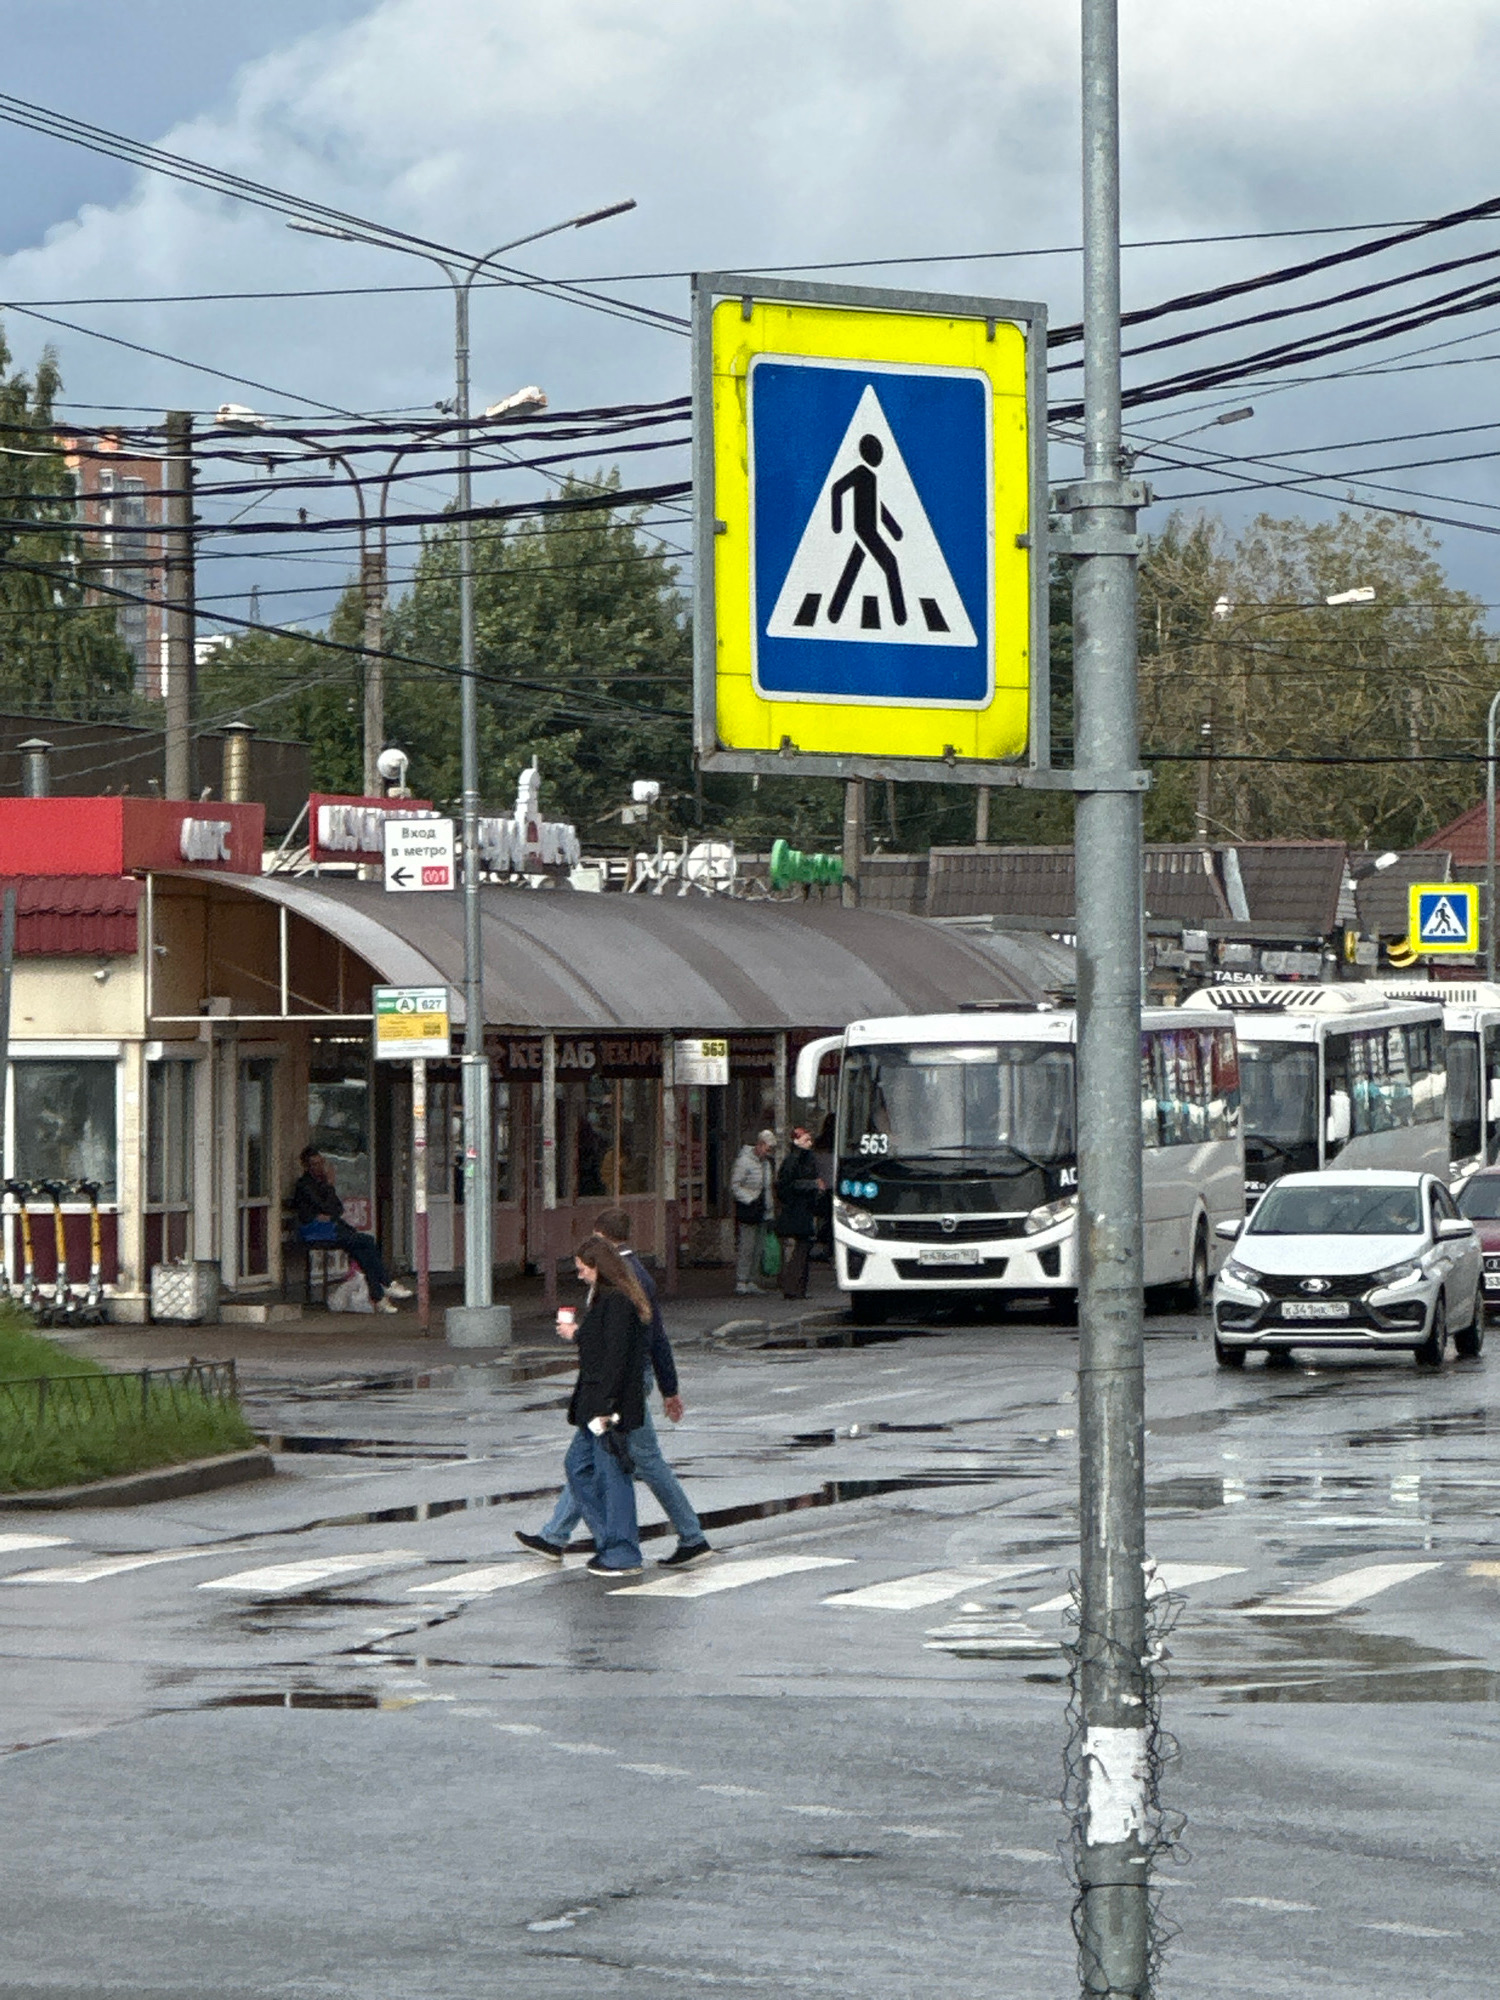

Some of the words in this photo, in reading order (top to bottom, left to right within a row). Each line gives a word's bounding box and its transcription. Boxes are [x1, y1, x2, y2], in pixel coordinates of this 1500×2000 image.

[401, 827, 436, 840] Вход
[391, 848, 399, 857] в
[404, 846, 447, 858] метро
[1213, 970, 1264, 984] ТАБАК
[421, 999, 442, 1010] 627
[702, 1042, 725, 1057] 563
[860, 1133, 888, 1155] 563
